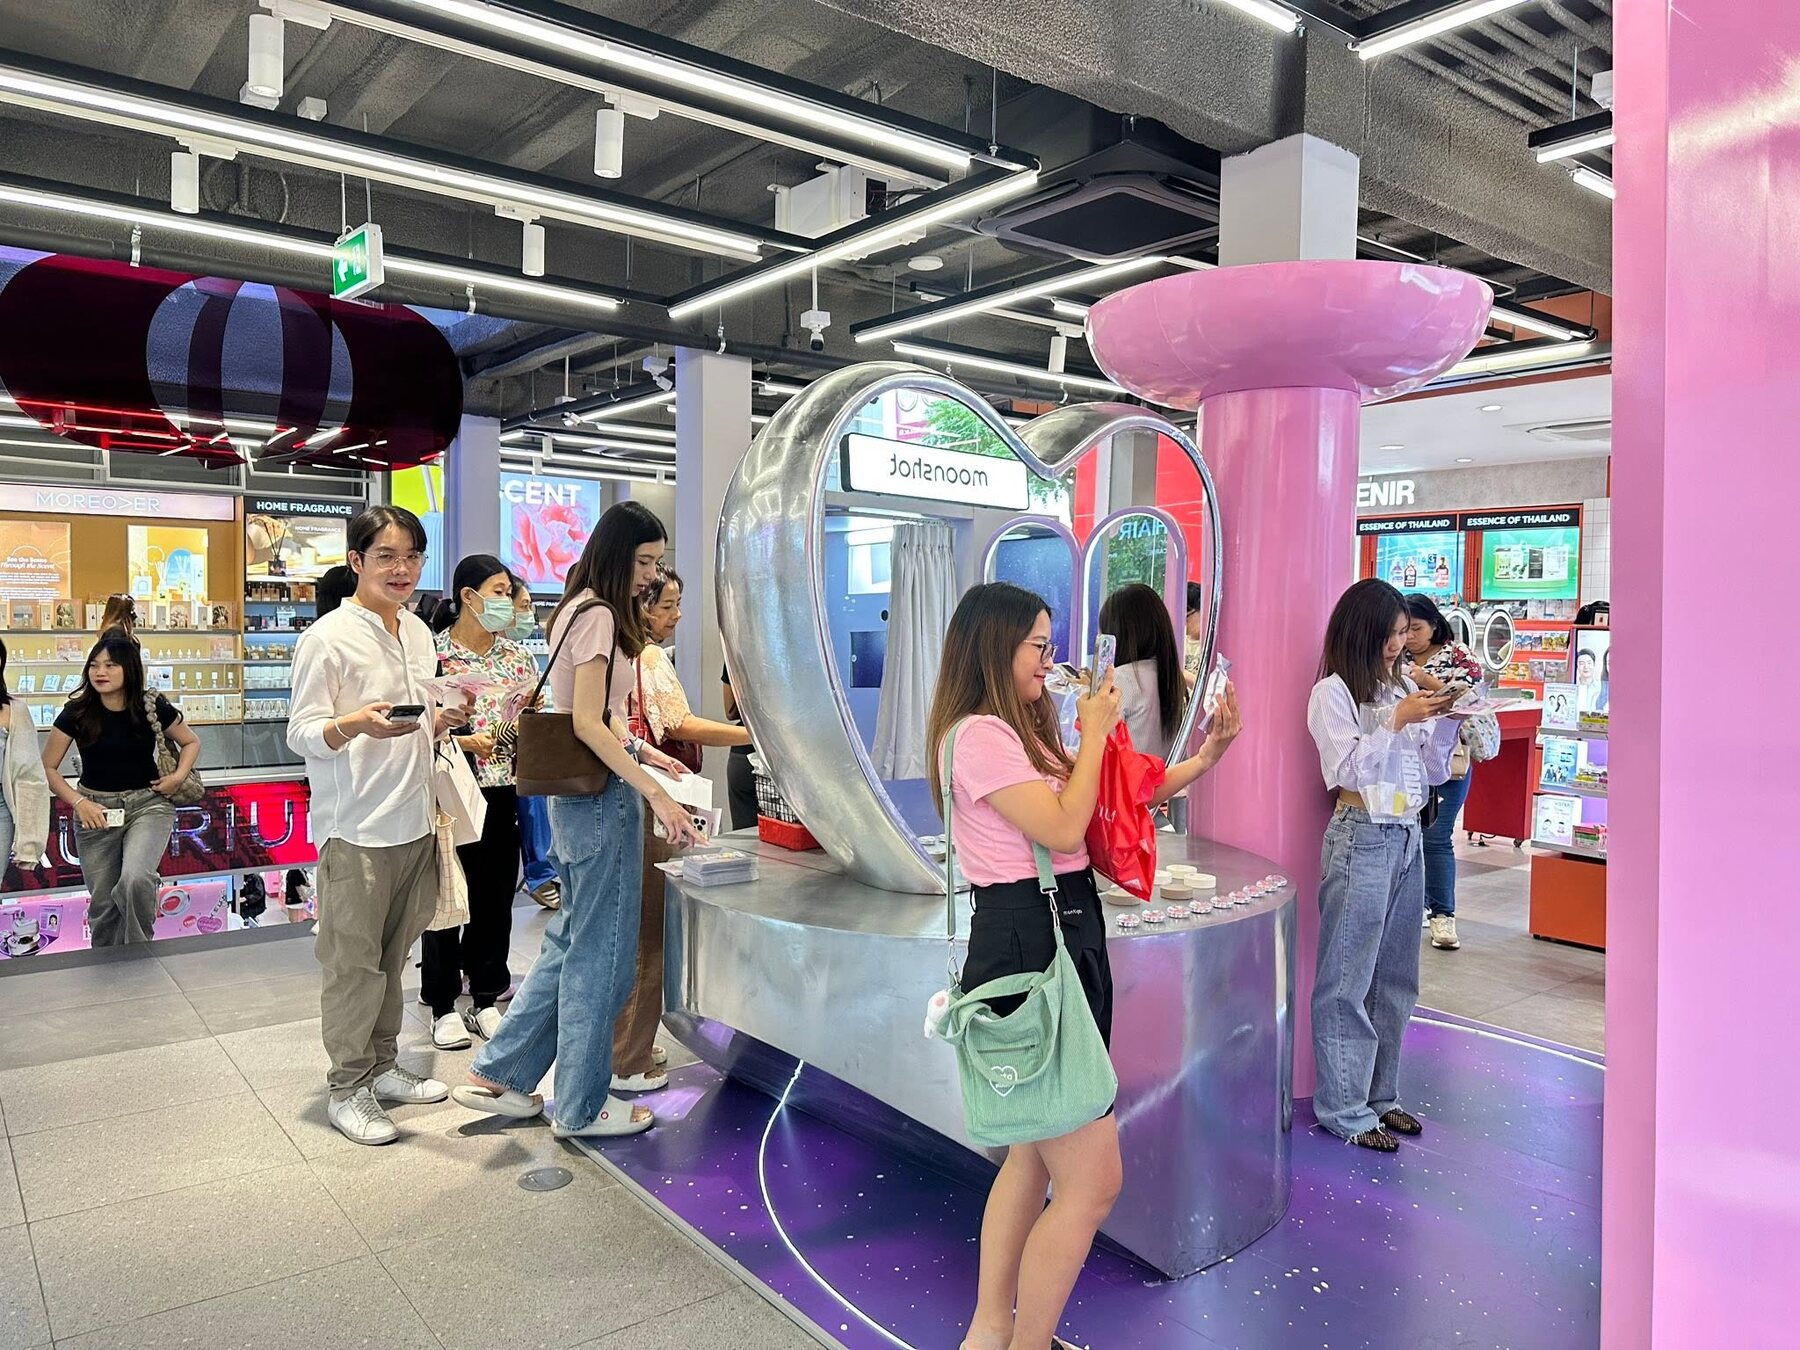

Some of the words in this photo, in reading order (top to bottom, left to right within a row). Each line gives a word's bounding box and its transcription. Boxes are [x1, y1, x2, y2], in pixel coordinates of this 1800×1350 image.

[499, 480, 582, 507] CENT
[1356, 480, 1415, 507] ENIR
[256, 501, 288, 511] HOME
[289, 503, 352, 514] FRAGRANCE
[1360, 522, 1394, 531] ESSENCE
[1395, 521, 1408, 529] OF
[1408, 519, 1450, 528] THAILAND
[1467, 517, 1506, 526] ESSENCE
[1507, 515, 1522, 524] OF
[1522, 513, 1570, 523] THAILAND
